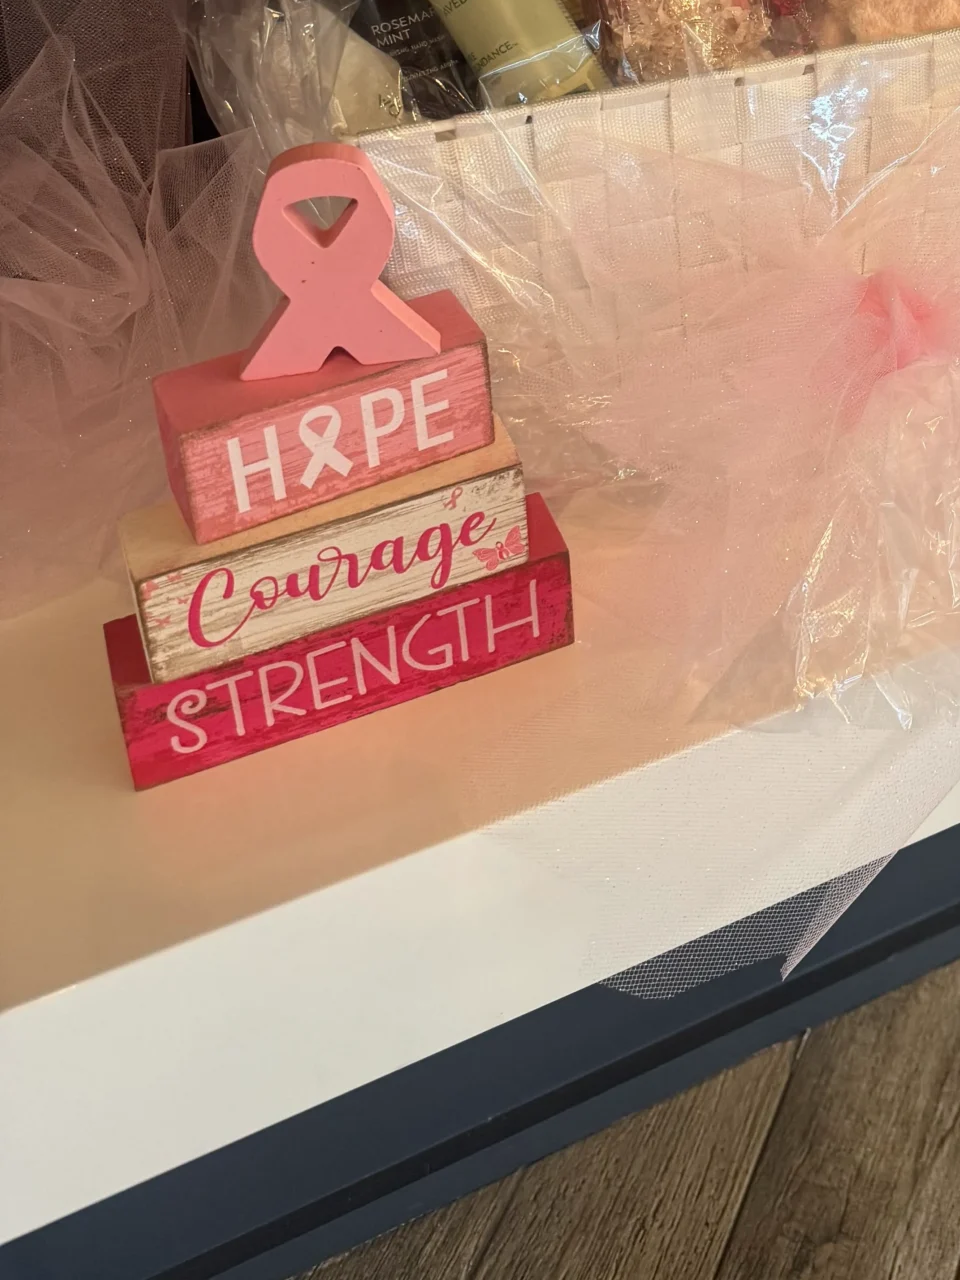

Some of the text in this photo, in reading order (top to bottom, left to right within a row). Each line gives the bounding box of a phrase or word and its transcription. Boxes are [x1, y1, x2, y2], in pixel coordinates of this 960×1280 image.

[376, 28, 411, 48] MINT
[226, 369, 454, 514] HOPE
[188, 511, 497, 648] Courage
[165, 580, 540, 754] STRENGTH
